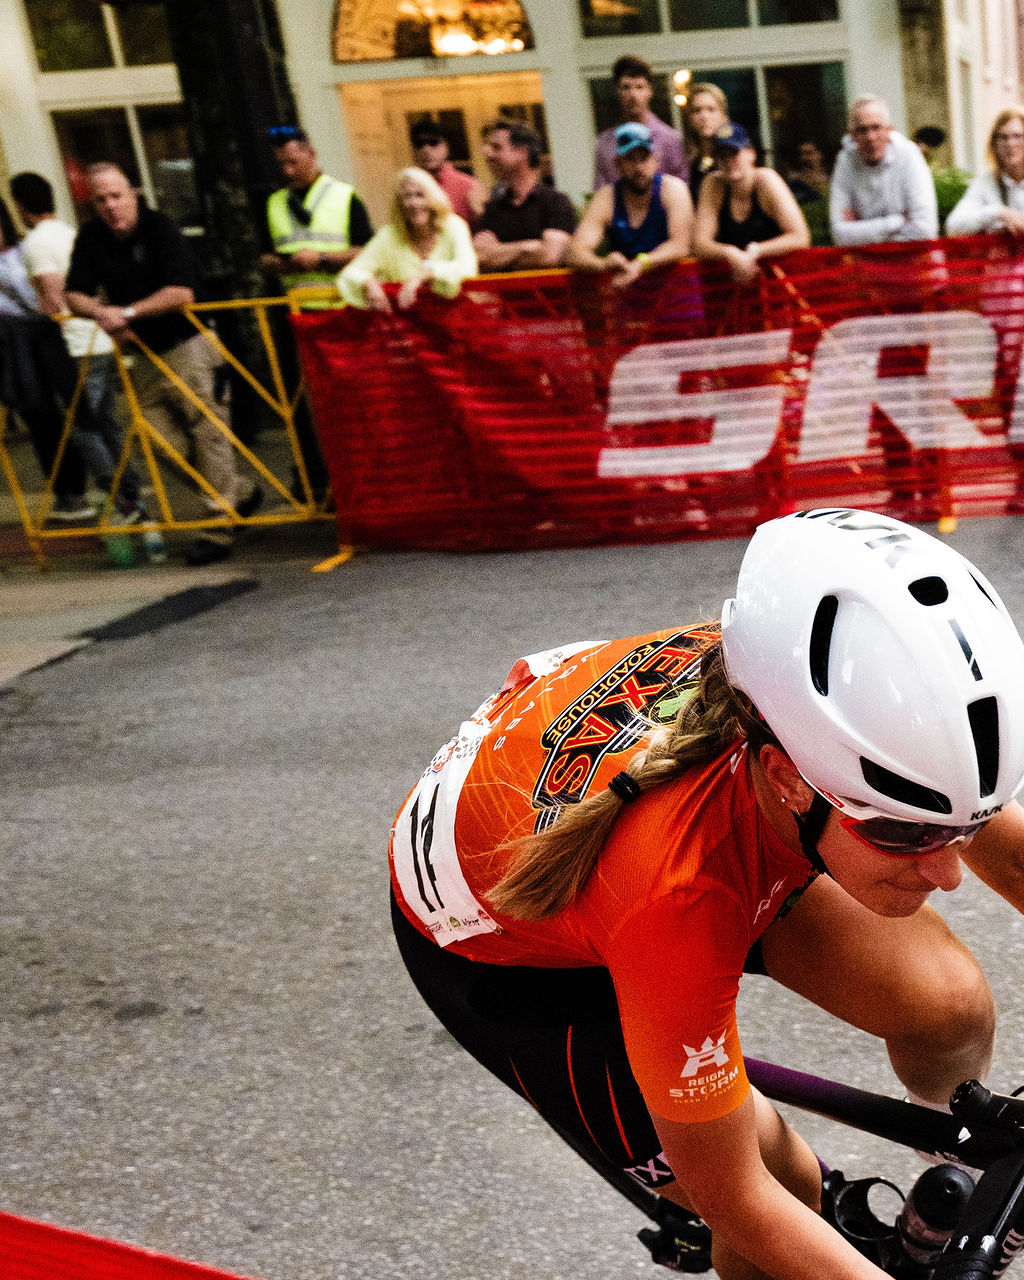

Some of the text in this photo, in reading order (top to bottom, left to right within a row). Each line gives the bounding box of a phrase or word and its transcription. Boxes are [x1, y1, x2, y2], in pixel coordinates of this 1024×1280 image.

[546, 644, 655, 745] ROADHOUSE
[669, 1065, 739, 1098] STORM
[688, 1067, 727, 1087] REIGN
